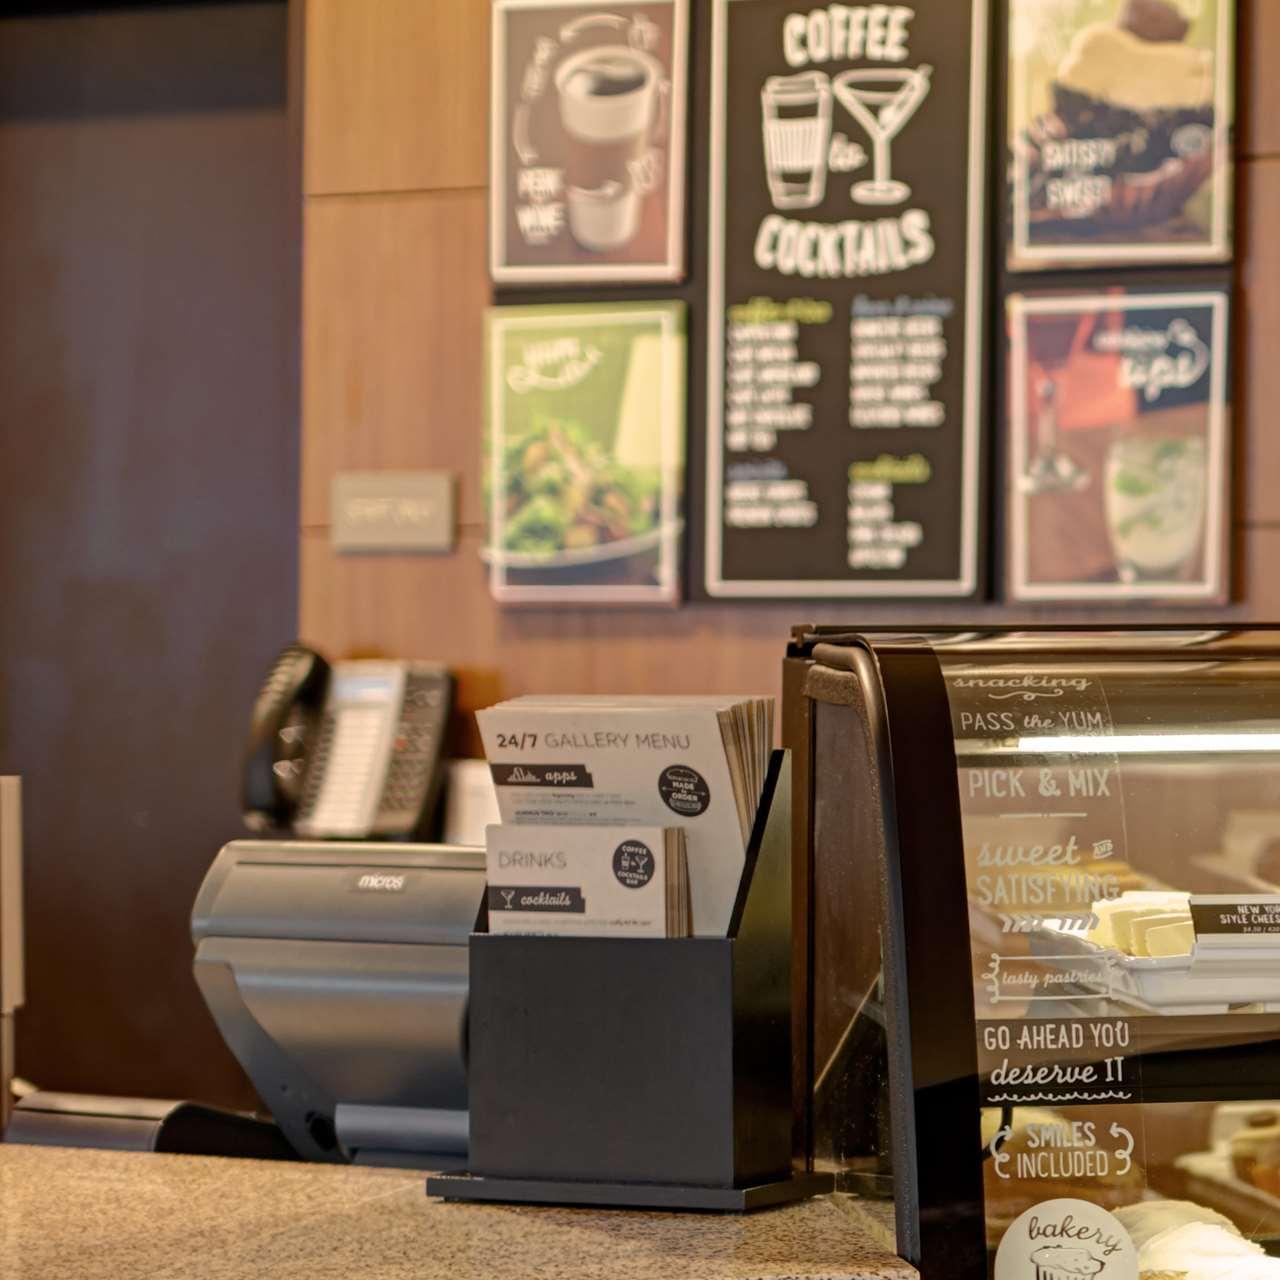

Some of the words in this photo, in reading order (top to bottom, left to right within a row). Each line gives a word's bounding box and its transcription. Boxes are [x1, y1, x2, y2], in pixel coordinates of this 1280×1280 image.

[783, 3, 915, 67] COFFEE
[754, 208, 935, 278] COCKTAILS
[953, 675, 1092, 690] snacking
[961, 712, 1015, 730] PASS
[1023, 715, 1055, 728] the
[1058, 711, 1103, 729] YUM
[496, 734, 537, 749] 24/7
[544, 733, 629, 748] GALLERY
[636, 734, 690, 750] MENU
[545, 769, 578, 784] apps
[968, 770, 1026, 798] PICK
[1038, 768, 1061, 796] &
[1068, 768, 1111, 797] MIX
[498, 851, 567, 869] DRINKS
[976, 836, 1081, 867] sweet
[520, 892, 572, 906] cocktails
[976, 872, 1120, 905] SATISFYING
[1220, 914, 1248, 924] STYLE
[1237, 906, 1260, 914] NEW
[1002, 971, 1040, 989] tasty
[984, 1026, 1010, 1050] GO
[1017, 1023, 1083, 1050] AHEAD
[1090, 1020, 1129, 1048] YOU
[991, 1058, 1098, 1085] deserve
[1104, 1056, 1125, 1082] IT
[1026, 1121, 1096, 1148] SMILES
[1017, 1151, 1109, 1179] INCLUDED
[1029, 1215, 1123, 1256] bakery
